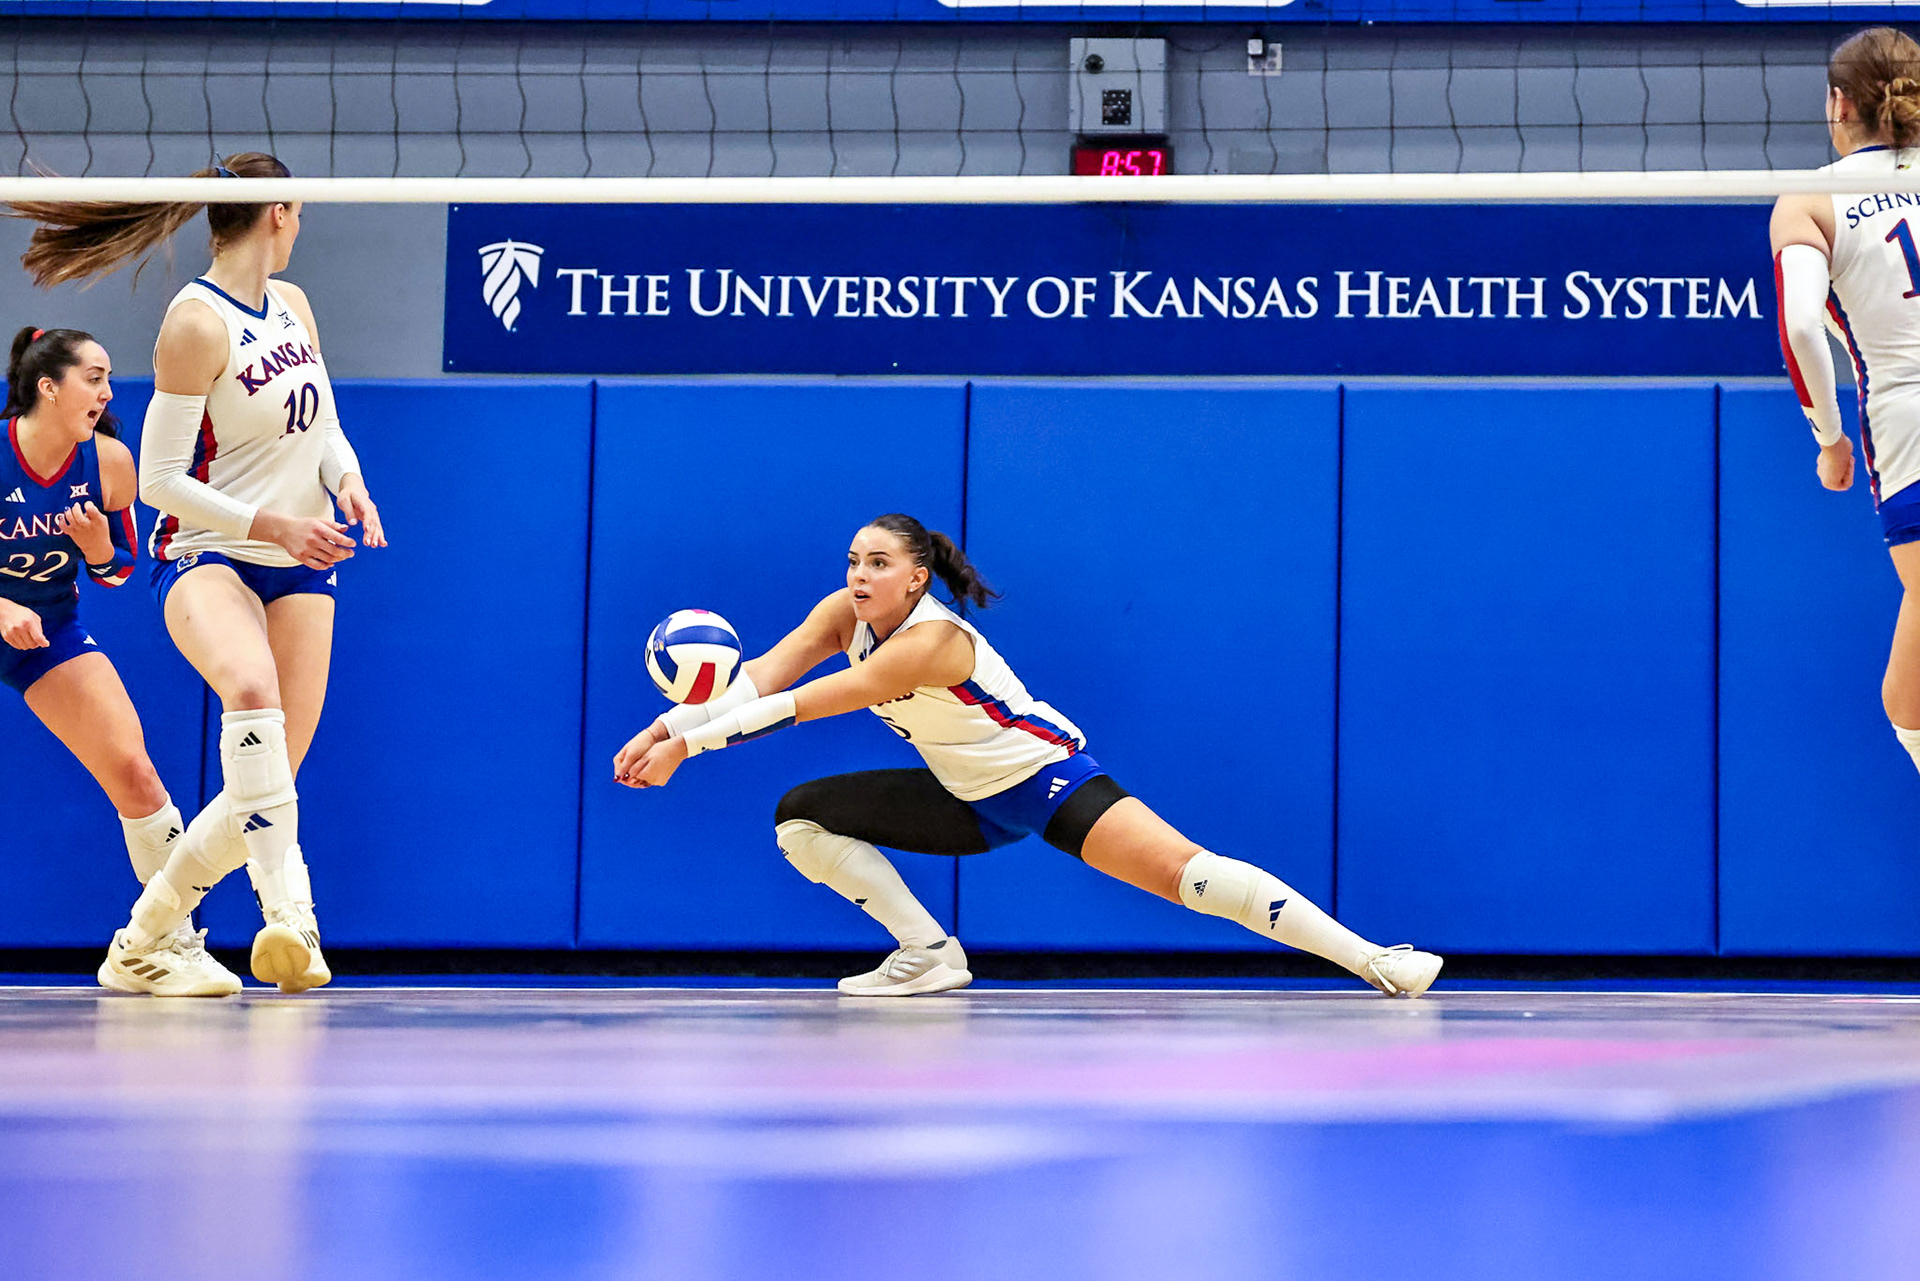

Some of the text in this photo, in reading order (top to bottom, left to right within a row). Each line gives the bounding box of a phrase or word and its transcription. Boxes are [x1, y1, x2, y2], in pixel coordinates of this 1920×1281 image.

[555, 267, 1763, 320] THE UNIVERSITY OF KANSAS HEALTH SYSTEM
[235, 341, 318, 397] KANSA
[278, 382, 319, 440] 10
[0, 513, 66, 540] KANS
[0, 550, 70, 583] 22
